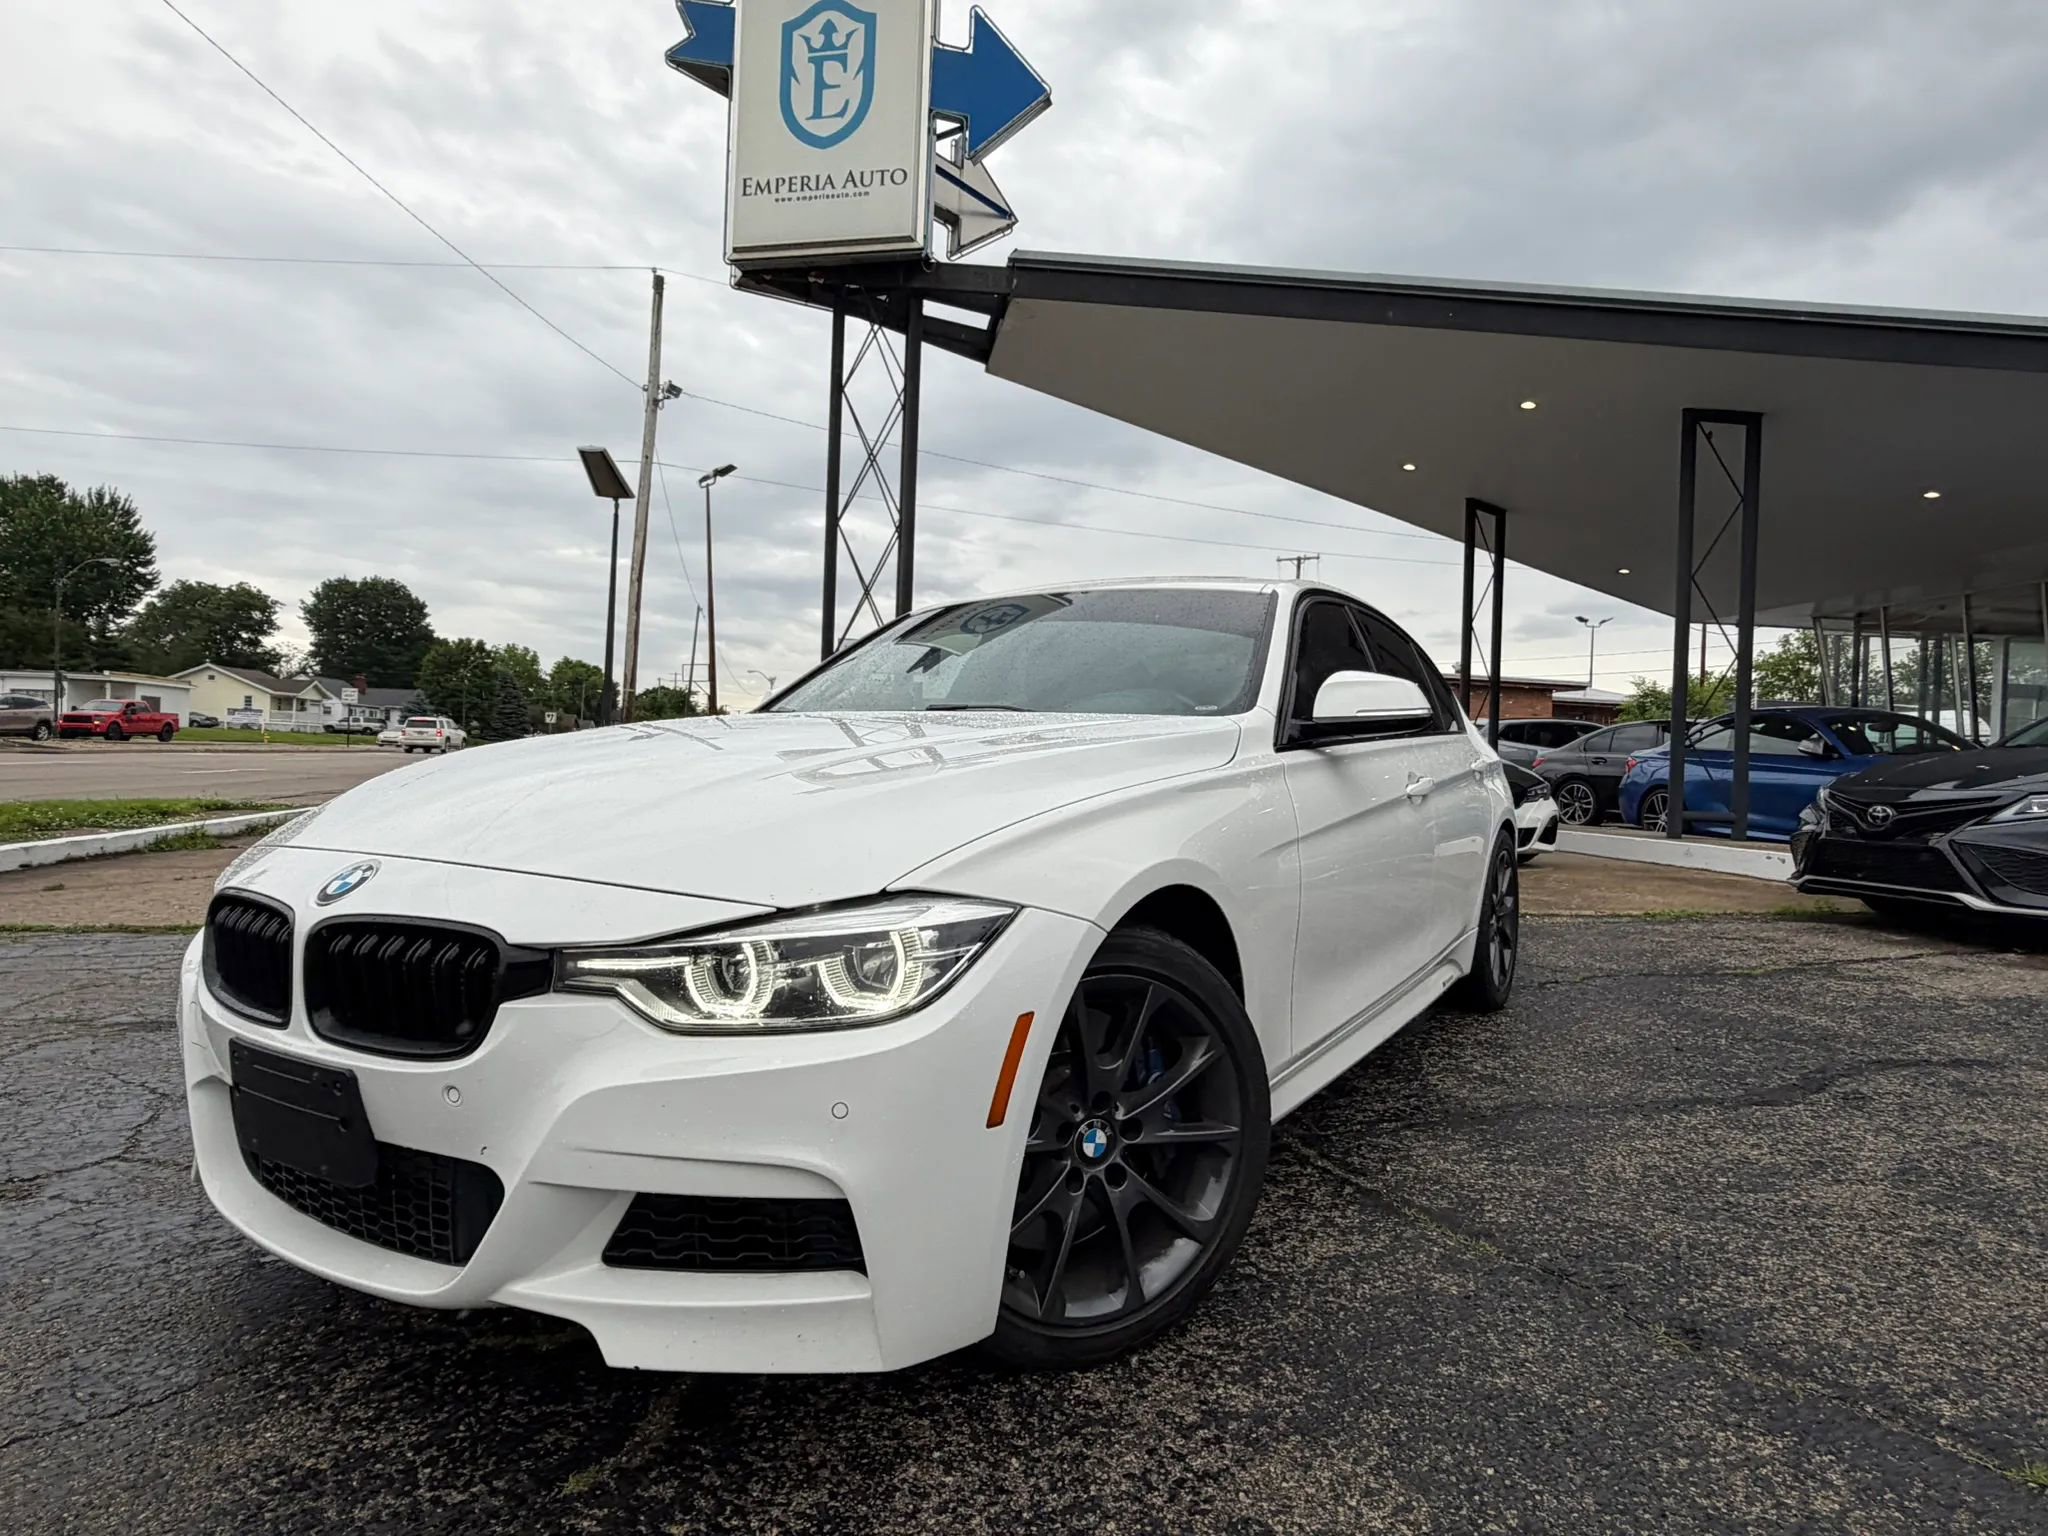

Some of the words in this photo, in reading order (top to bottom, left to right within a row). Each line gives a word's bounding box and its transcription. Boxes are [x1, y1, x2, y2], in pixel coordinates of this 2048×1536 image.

[805, 52, 850, 120] E
[742, 173, 836, 197] EMPERIA
[842, 167, 908, 190] AUTO
